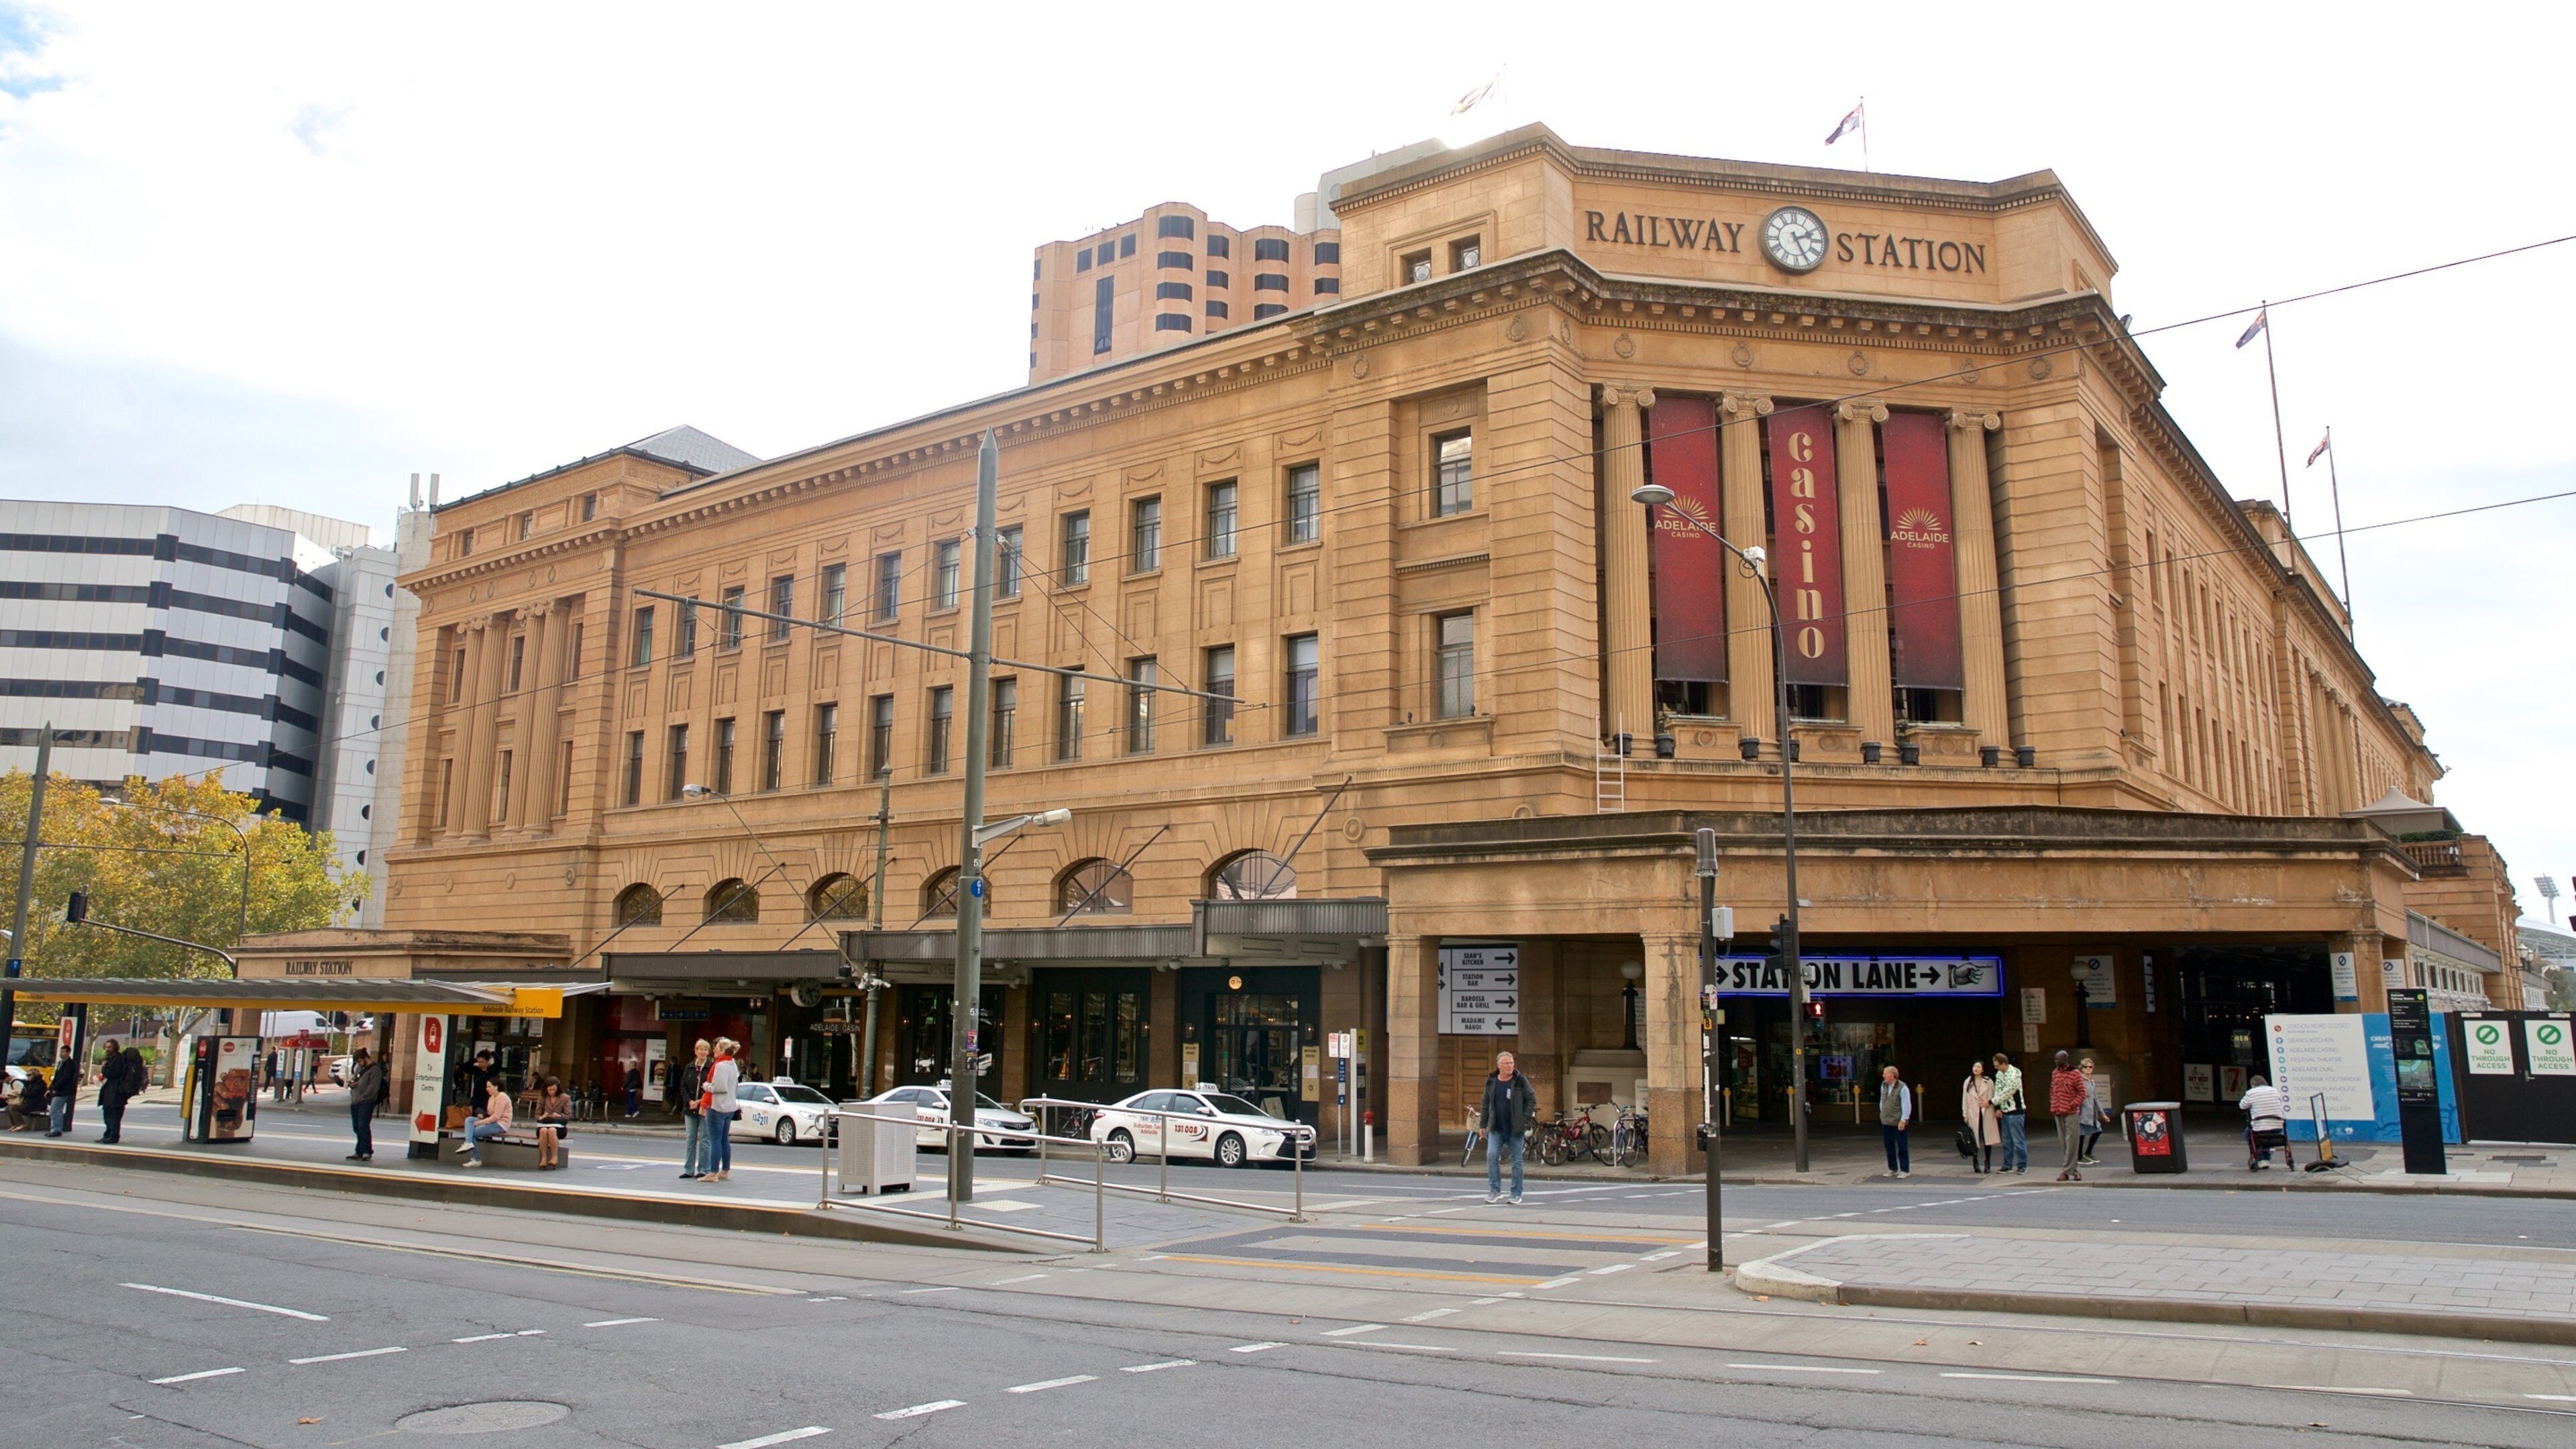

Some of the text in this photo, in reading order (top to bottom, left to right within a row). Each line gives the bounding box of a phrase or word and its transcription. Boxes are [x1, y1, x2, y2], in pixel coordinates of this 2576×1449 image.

[1585, 210, 1985, 274] RAILWAY STATION
[1655, 520, 1717, 532] ADELAIDE
[1890, 531, 1949, 543] ADELAIDE
[286, 961, 353, 975] RAILWAY STATION
[1852, 963, 1917, 989] LANE
[504, 1006, 524, 1014] Railway
[810, 1024, 839, 1032] ADELAIDE
[415, 1073, 443, 1083] Entertainment
[421, 1084, 434, 1092] Centre
